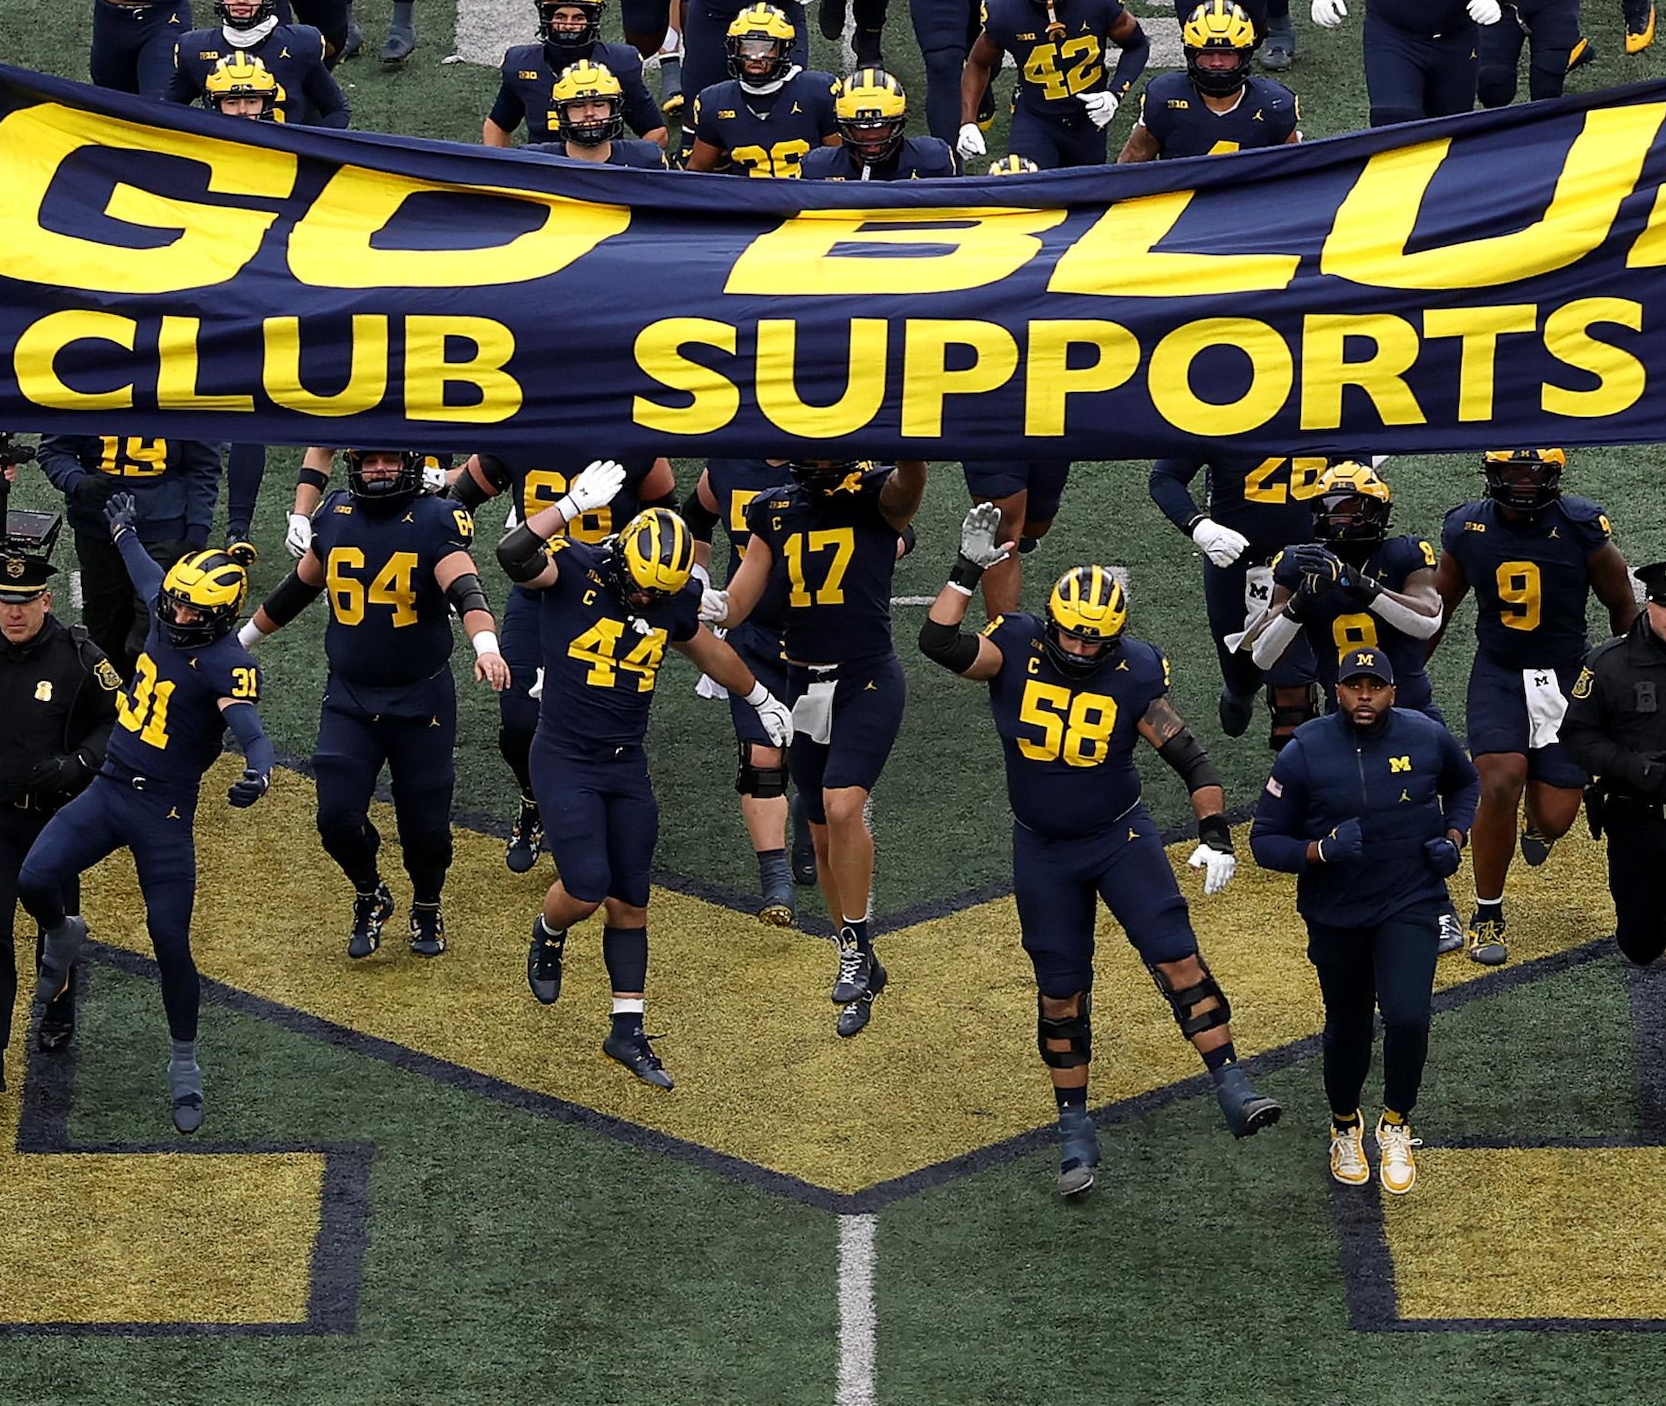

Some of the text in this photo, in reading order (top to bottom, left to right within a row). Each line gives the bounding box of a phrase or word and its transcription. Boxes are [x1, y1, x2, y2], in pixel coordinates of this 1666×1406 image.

[1024, 40, 1101, 100] 42
[14, 310, 522, 423] CLUB
[633, 297, 1645, 438] SUPPORTS
[453, 510, 474, 537] 64
[772, 517, 782, 531] C
[784, 528, 854, 607] 17
[1420, 541, 1436, 565] 8
[326, 547, 418, 627] 64
[583, 590, 596, 605] C
[1496, 562, 1541, 631] 9
[568, 617, 667, 692] 44
[1333, 613, 1378, 662] 8
[232, 668, 257, 697] 31
[1028, 657, 1040, 674] C
[115, 654, 175, 749] 31
[1018, 679, 1117, 767] 58
[1389, 757, 1412, 773] M
